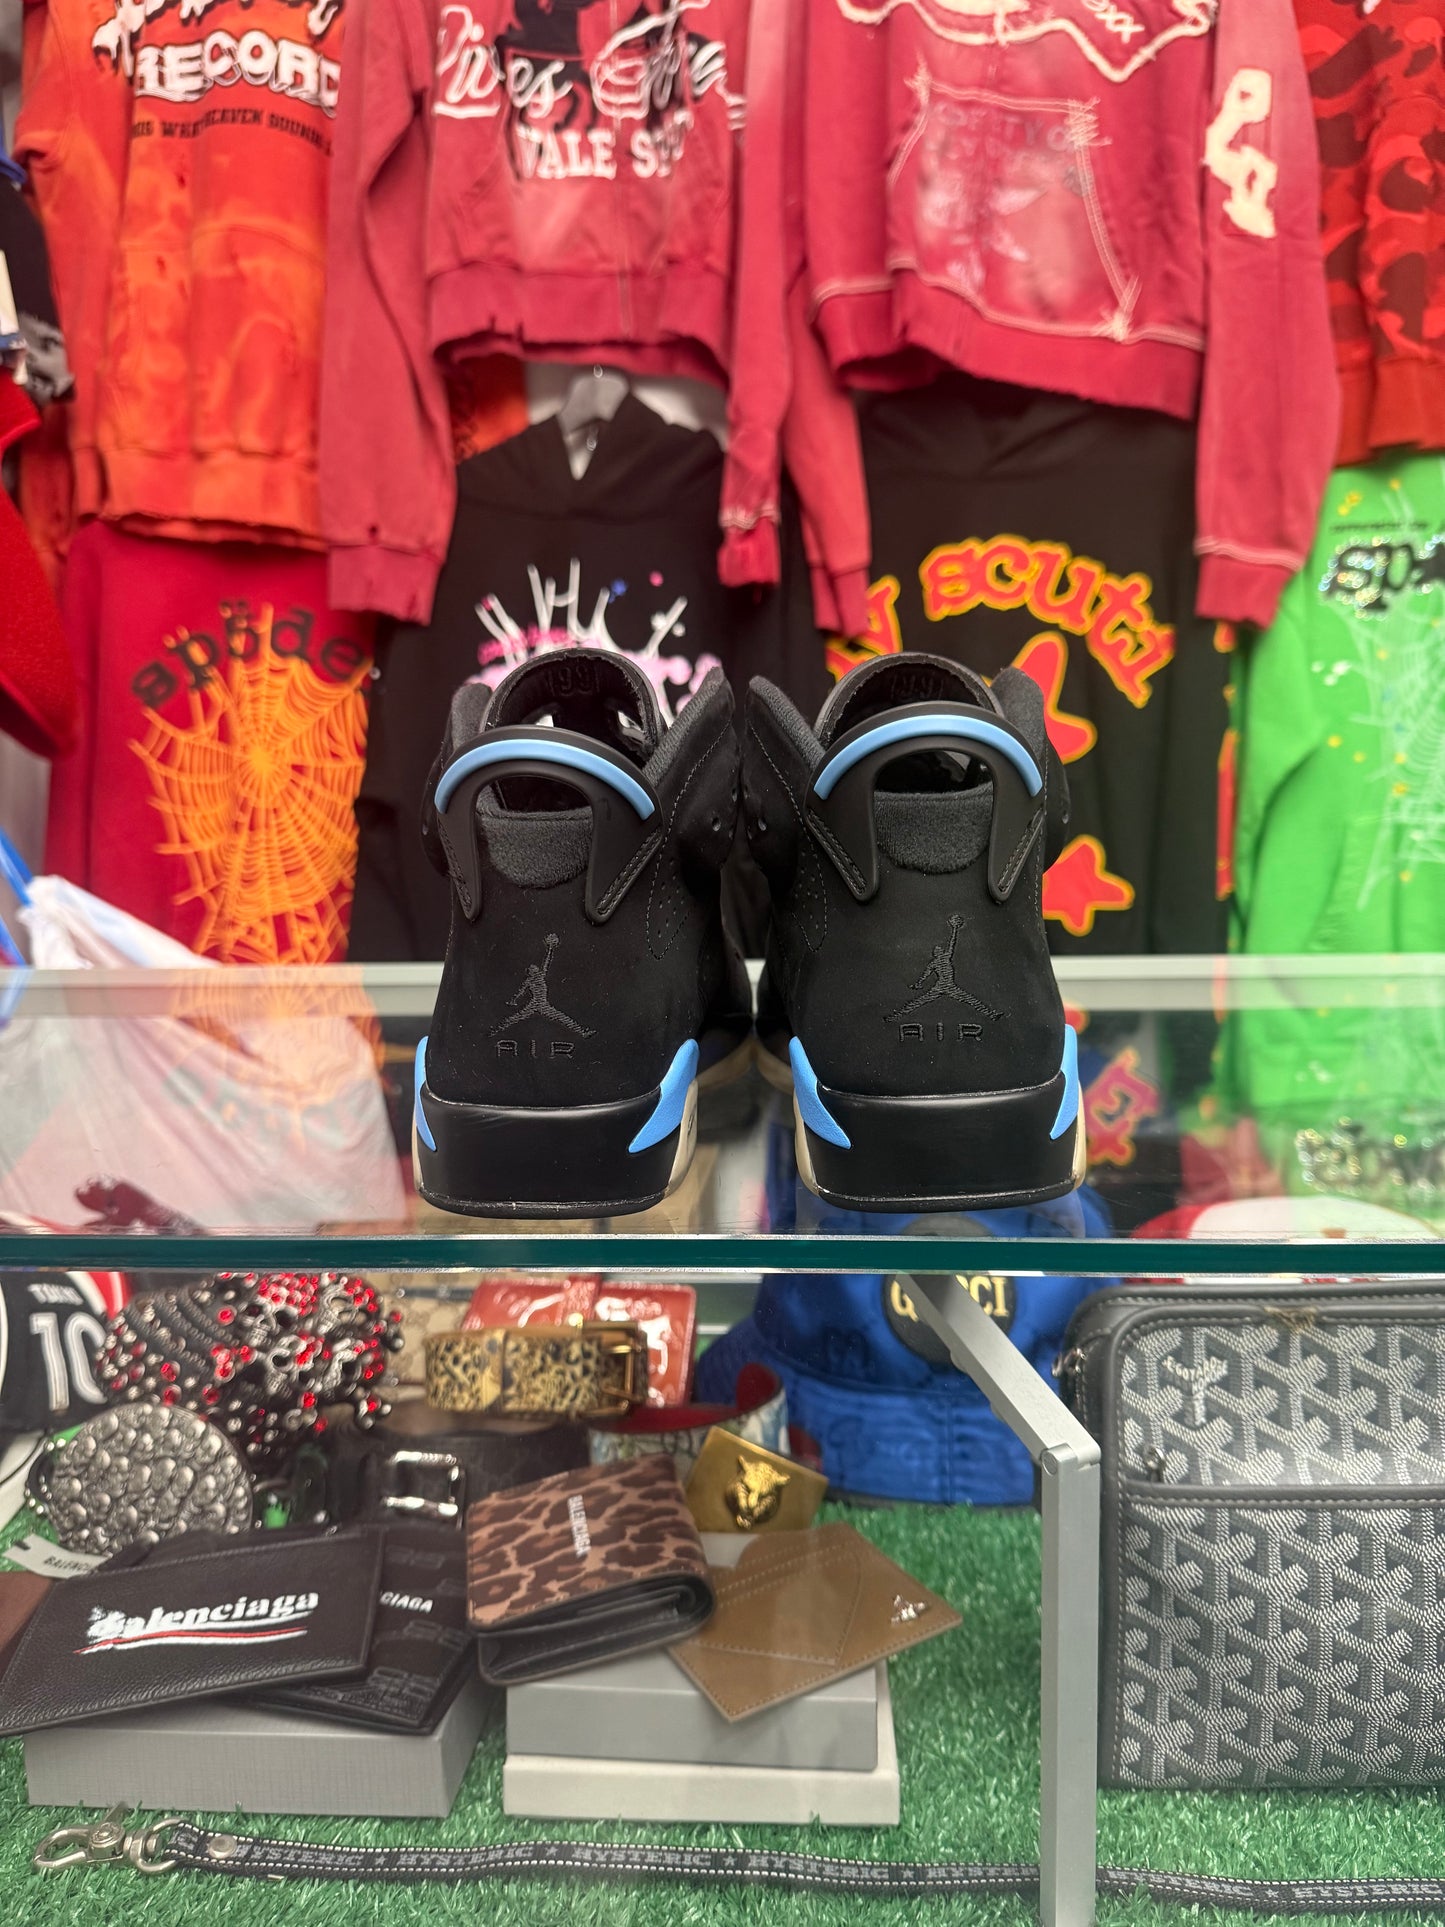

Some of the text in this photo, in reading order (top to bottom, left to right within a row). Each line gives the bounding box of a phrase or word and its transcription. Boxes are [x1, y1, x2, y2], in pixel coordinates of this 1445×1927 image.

[899, 1022, 983, 1042] AIR
[496, 1039, 576, 1059] AIR
[890, 1274, 1010, 1324] GCI
[396, 1847, 535, 1867] HYSTERIC
[570, 1847, 712, 1868] HYSTERIC
[747, 1854, 891, 1880] HYSTERIC
